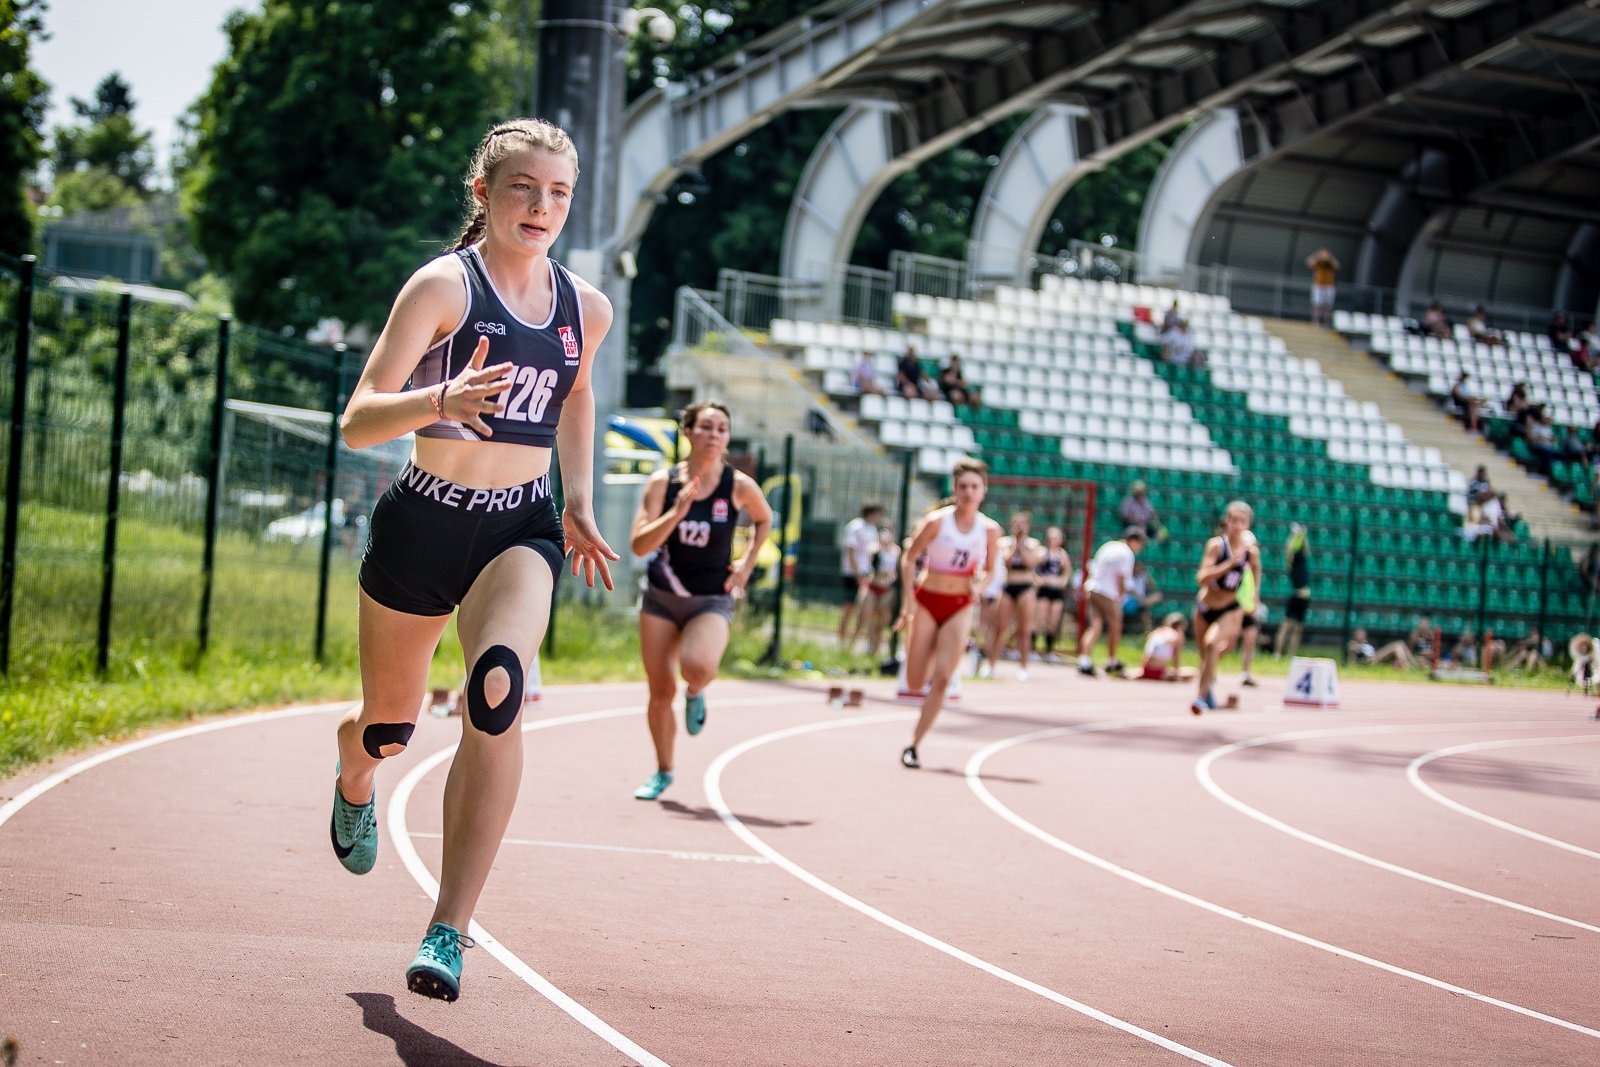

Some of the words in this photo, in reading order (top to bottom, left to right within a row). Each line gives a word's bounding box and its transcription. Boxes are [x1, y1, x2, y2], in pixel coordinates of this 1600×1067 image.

[494, 365, 558, 423] 126
[402, 463, 467, 508] NIKE
[466, 487, 523, 513] PRO
[678, 520, 711, 548] 123
[1296, 668, 1313, 695] 4
